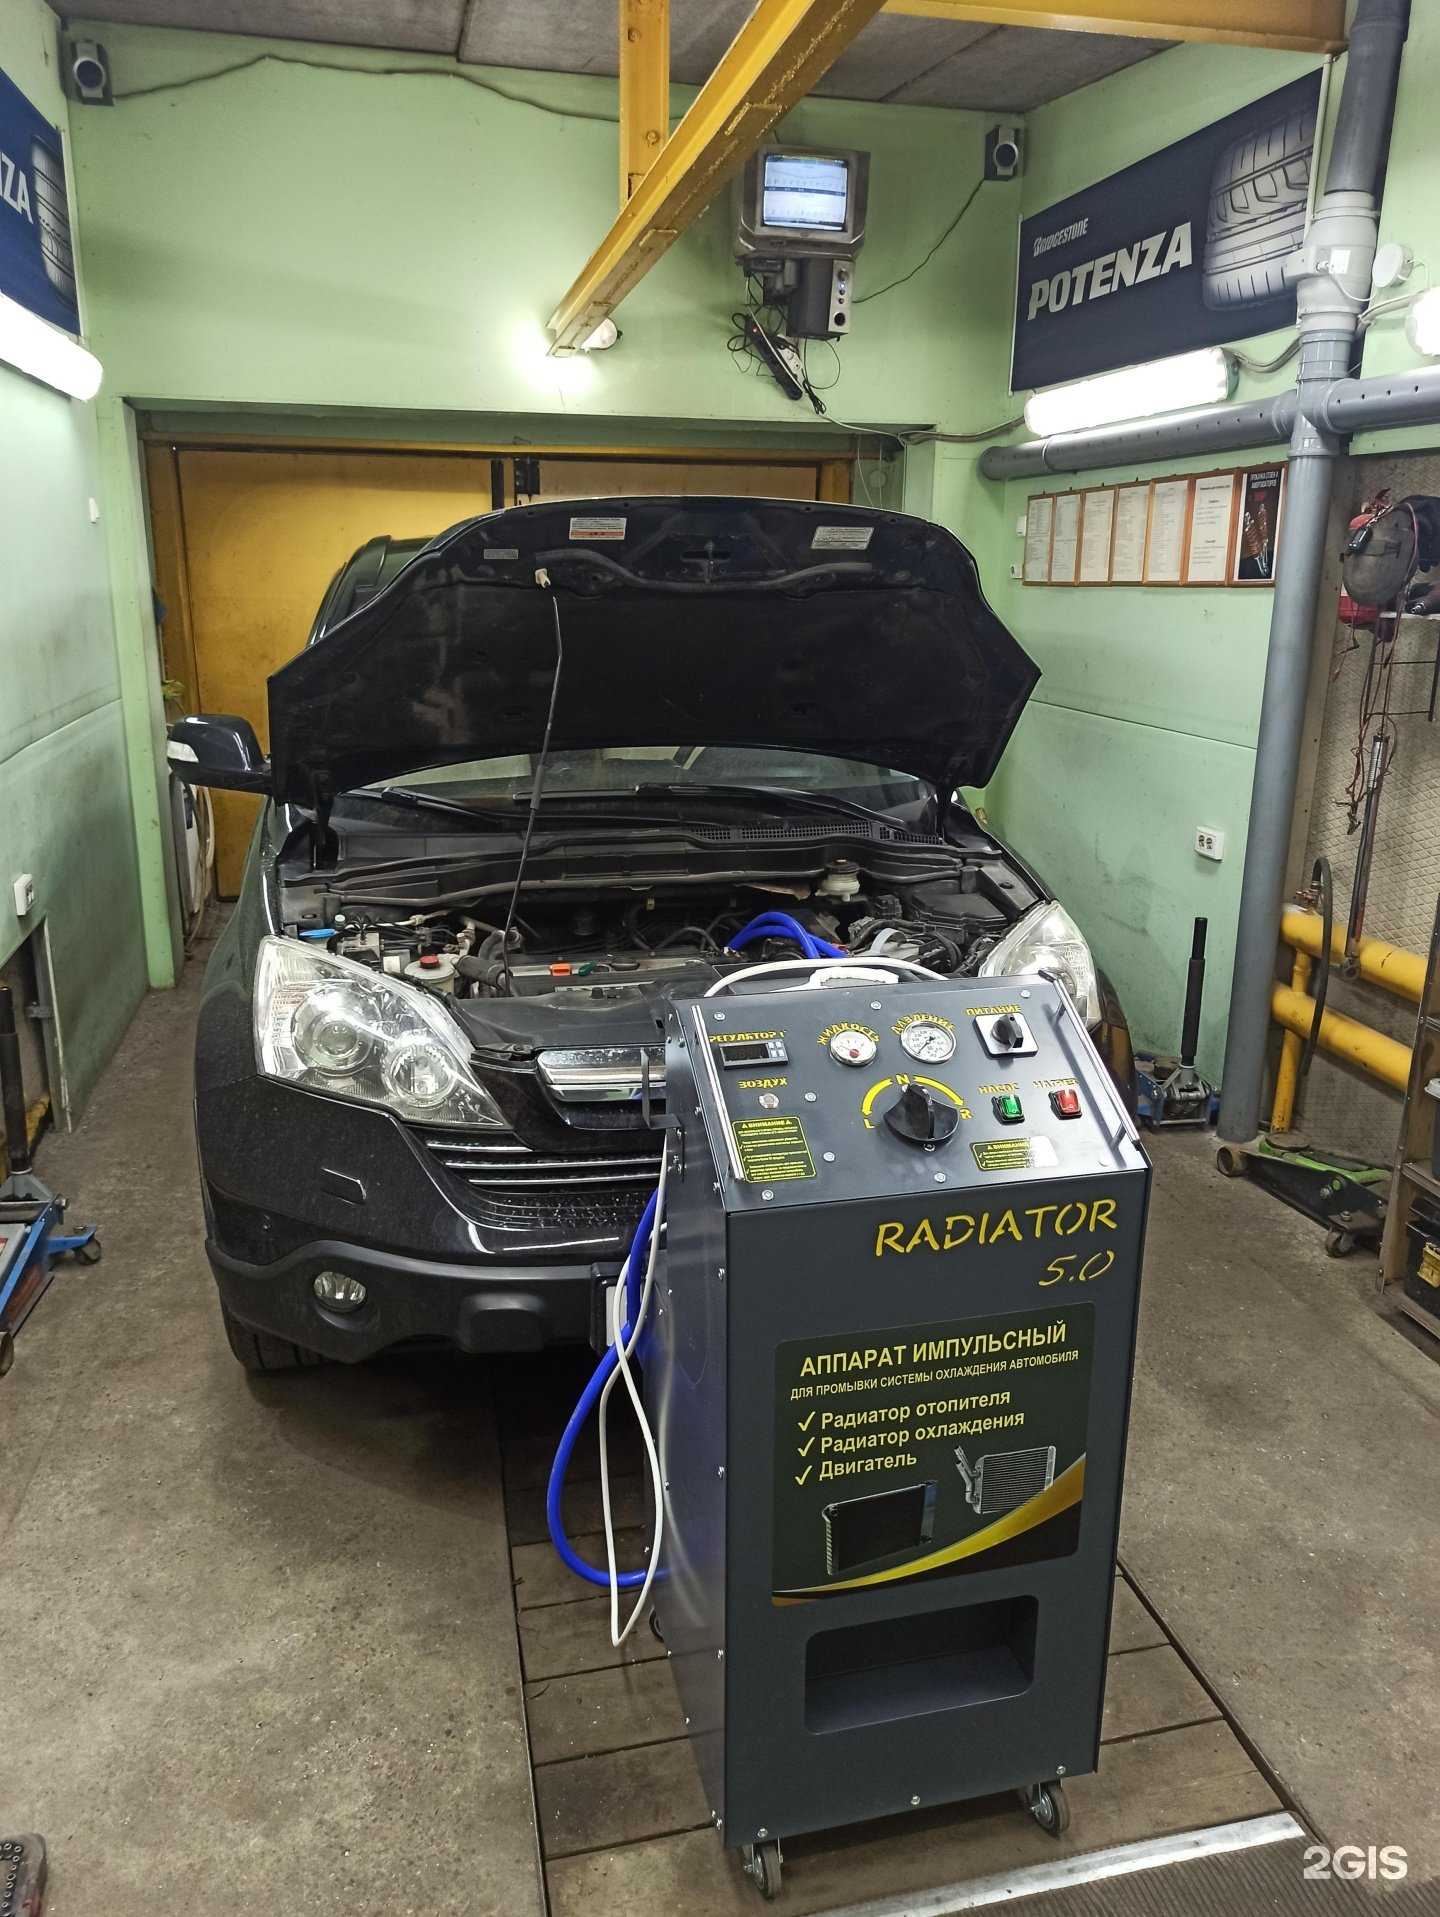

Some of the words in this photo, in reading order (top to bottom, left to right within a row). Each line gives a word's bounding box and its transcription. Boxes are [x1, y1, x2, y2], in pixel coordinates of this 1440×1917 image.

[0, 151, 34, 225] ZA
[1027, 221, 1192, 321] POTENZA
[965, 1004, 1022, 1016] ПИТАНИЕ
[895, 1073, 911, 1086] N
[863, 1118, 876, 1130] L
[959, 1106, 973, 1120] R
[875, 1198, 1119, 1257] RADIATOR
[1038, 1249, 1116, 1287] 5.0
[800, 1344, 907, 1378] АППАРАТ
[912, 1319, 1067, 1364] ИМПУЛЬСНЫЙ
[790, 1386, 813, 1401] ДЛЯ
[816, 1377, 878, 1396] ПРОМЫВКИ
[880, 1371, 933, 1389] СИСТЕМЫ
[935, 1360, 1008, 1381] ОХЛАЖДЕНИЯ
[1009, 1349, 1080, 1370] АВТОМОБИЛЯ
[821, 1403, 910, 1430] Радиатор
[916, 1390, 1011, 1417] отопителя
[820, 1428, 910, 1455] Радиатор
[915, 1412, 1026, 1441] охлаждения
[819, 1452, 917, 1481] Двигатель
